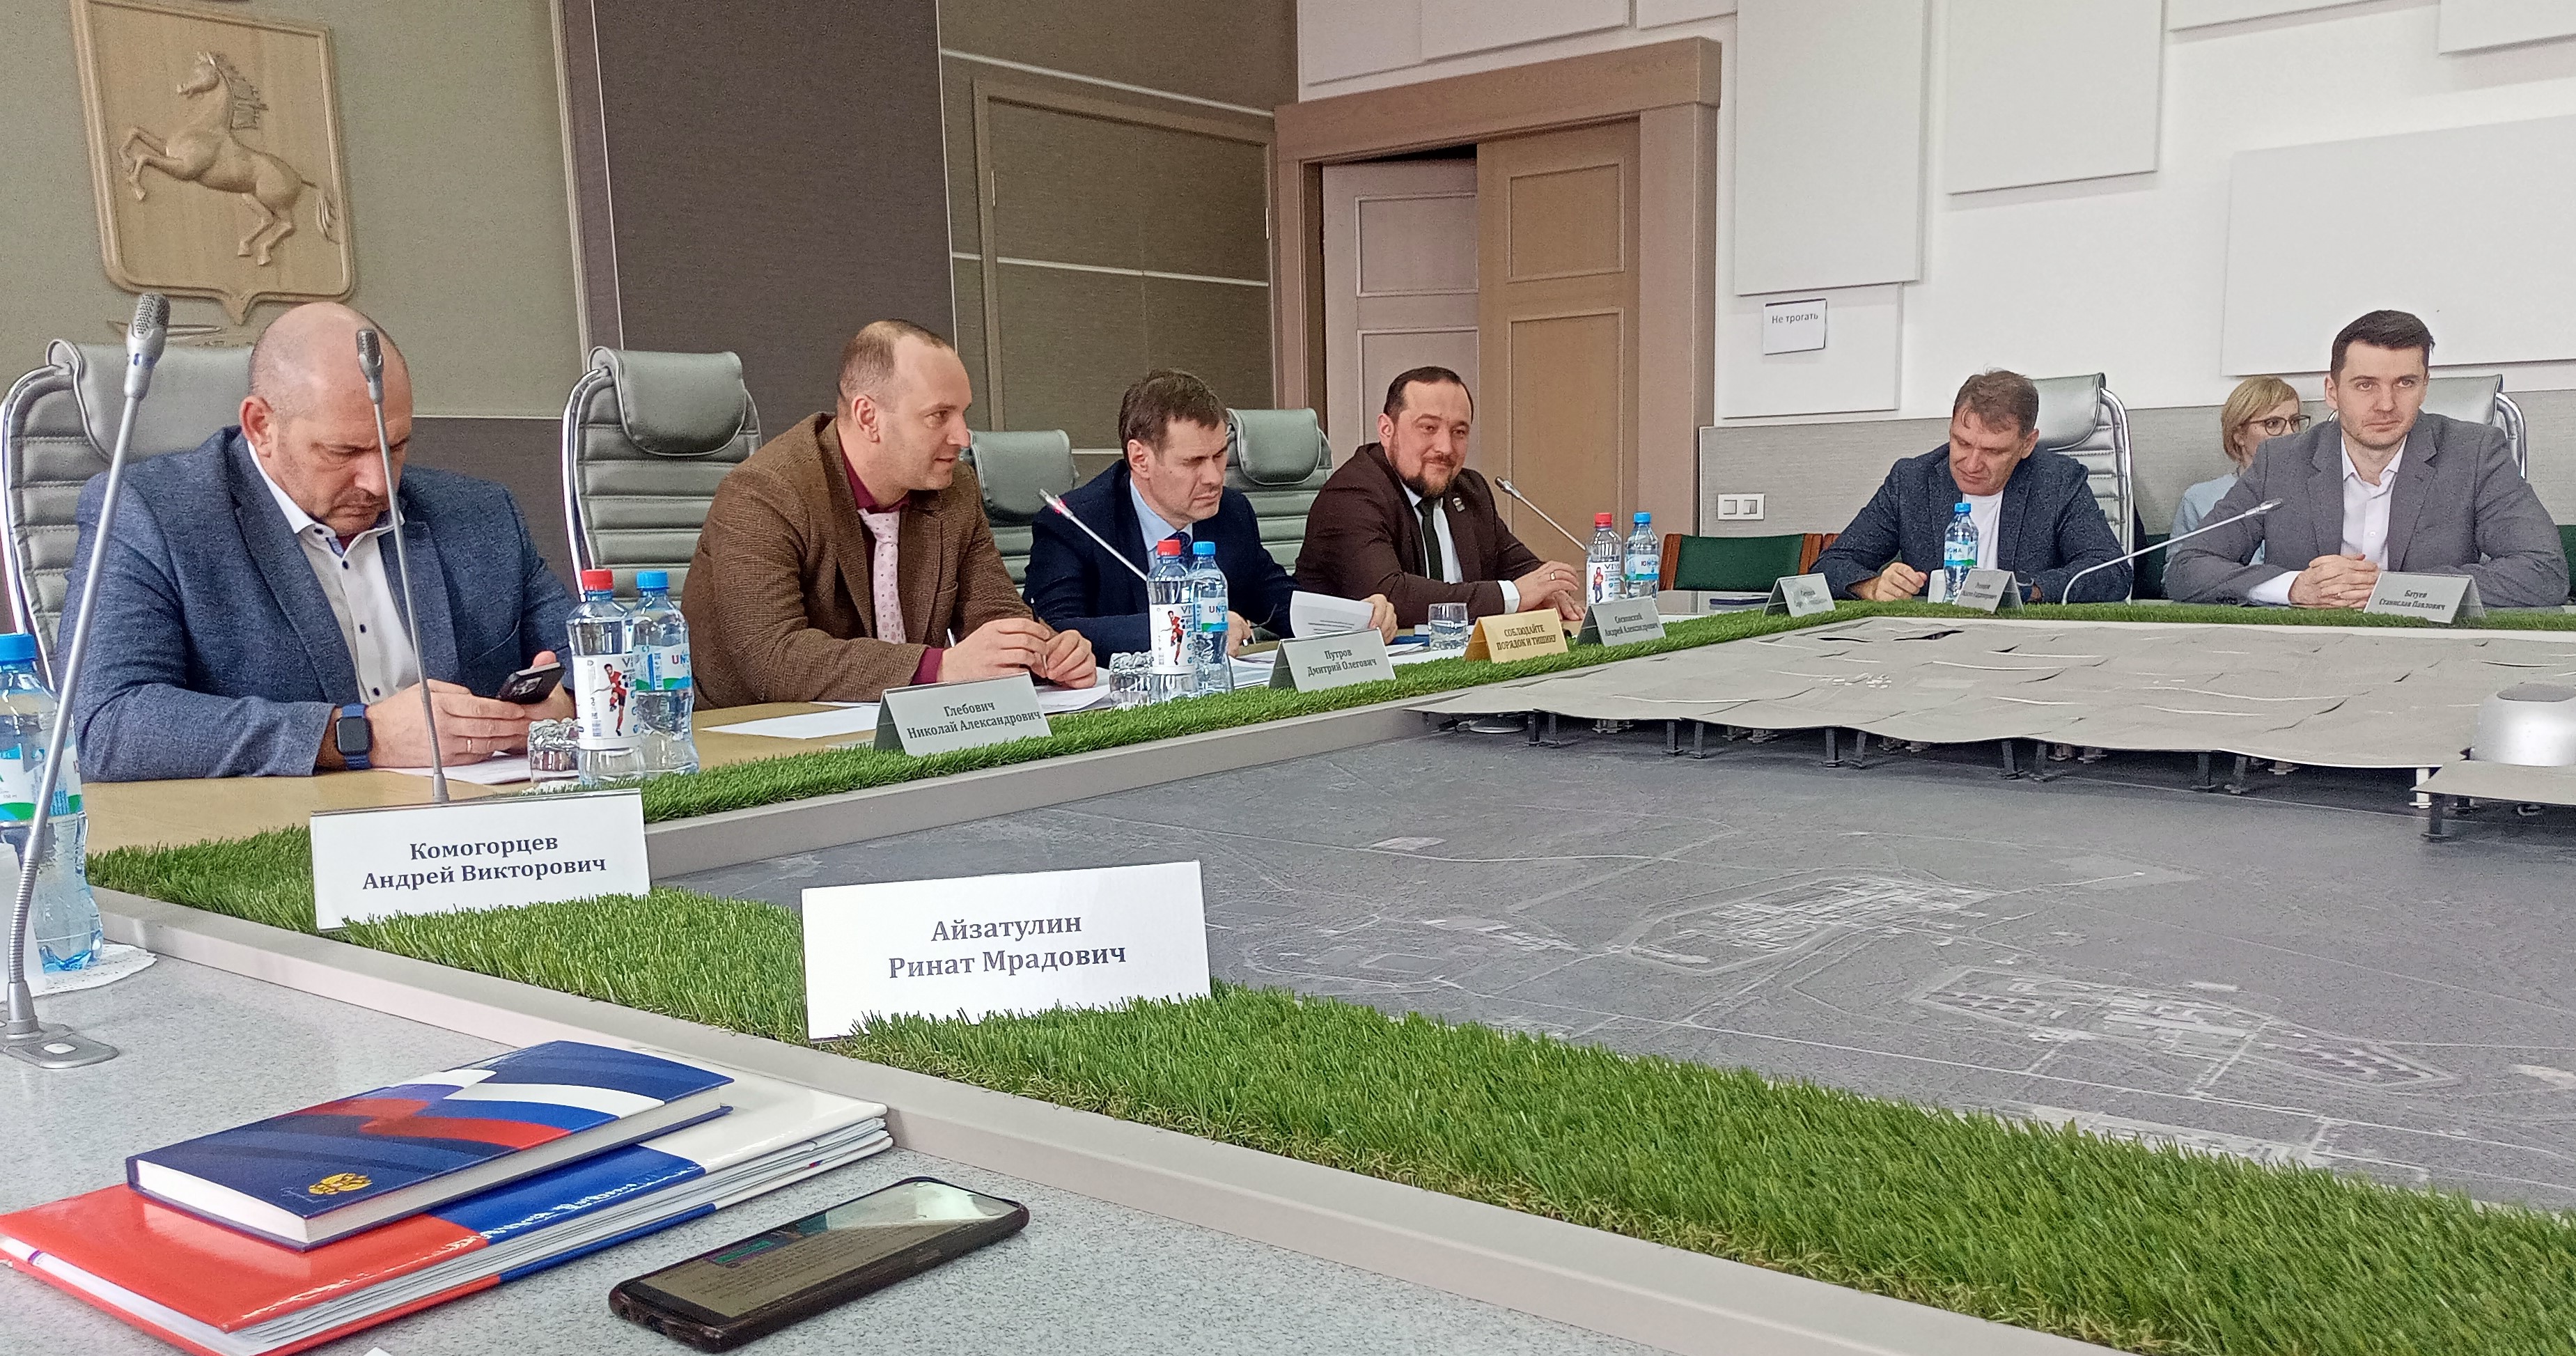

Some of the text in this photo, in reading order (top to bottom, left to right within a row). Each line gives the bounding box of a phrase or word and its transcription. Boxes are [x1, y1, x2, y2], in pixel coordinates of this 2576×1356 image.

[1772, 313, 1818, 325] Не трогать
[2379, 598, 2446, 610] Станислав Павлович
[1504, 624, 1545, 637] СОБЛЮДАЙТЕ
[1496, 634, 1556, 650] ПОРЯДОК И ТИШИНУ
[1324, 649, 1353, 662] Путров
[1307, 658, 1377, 678] Дмитрий Олегович
[944, 701, 995, 717] Глебович
[907, 711, 1042, 739] Николай Александрович
[409, 836, 559, 861] Комогорцев
[362, 858, 607, 891] Андрей Викторович
[930, 916, 1082, 942] Айзатулин
[889, 946, 1127, 979] Ринат Мрадович
